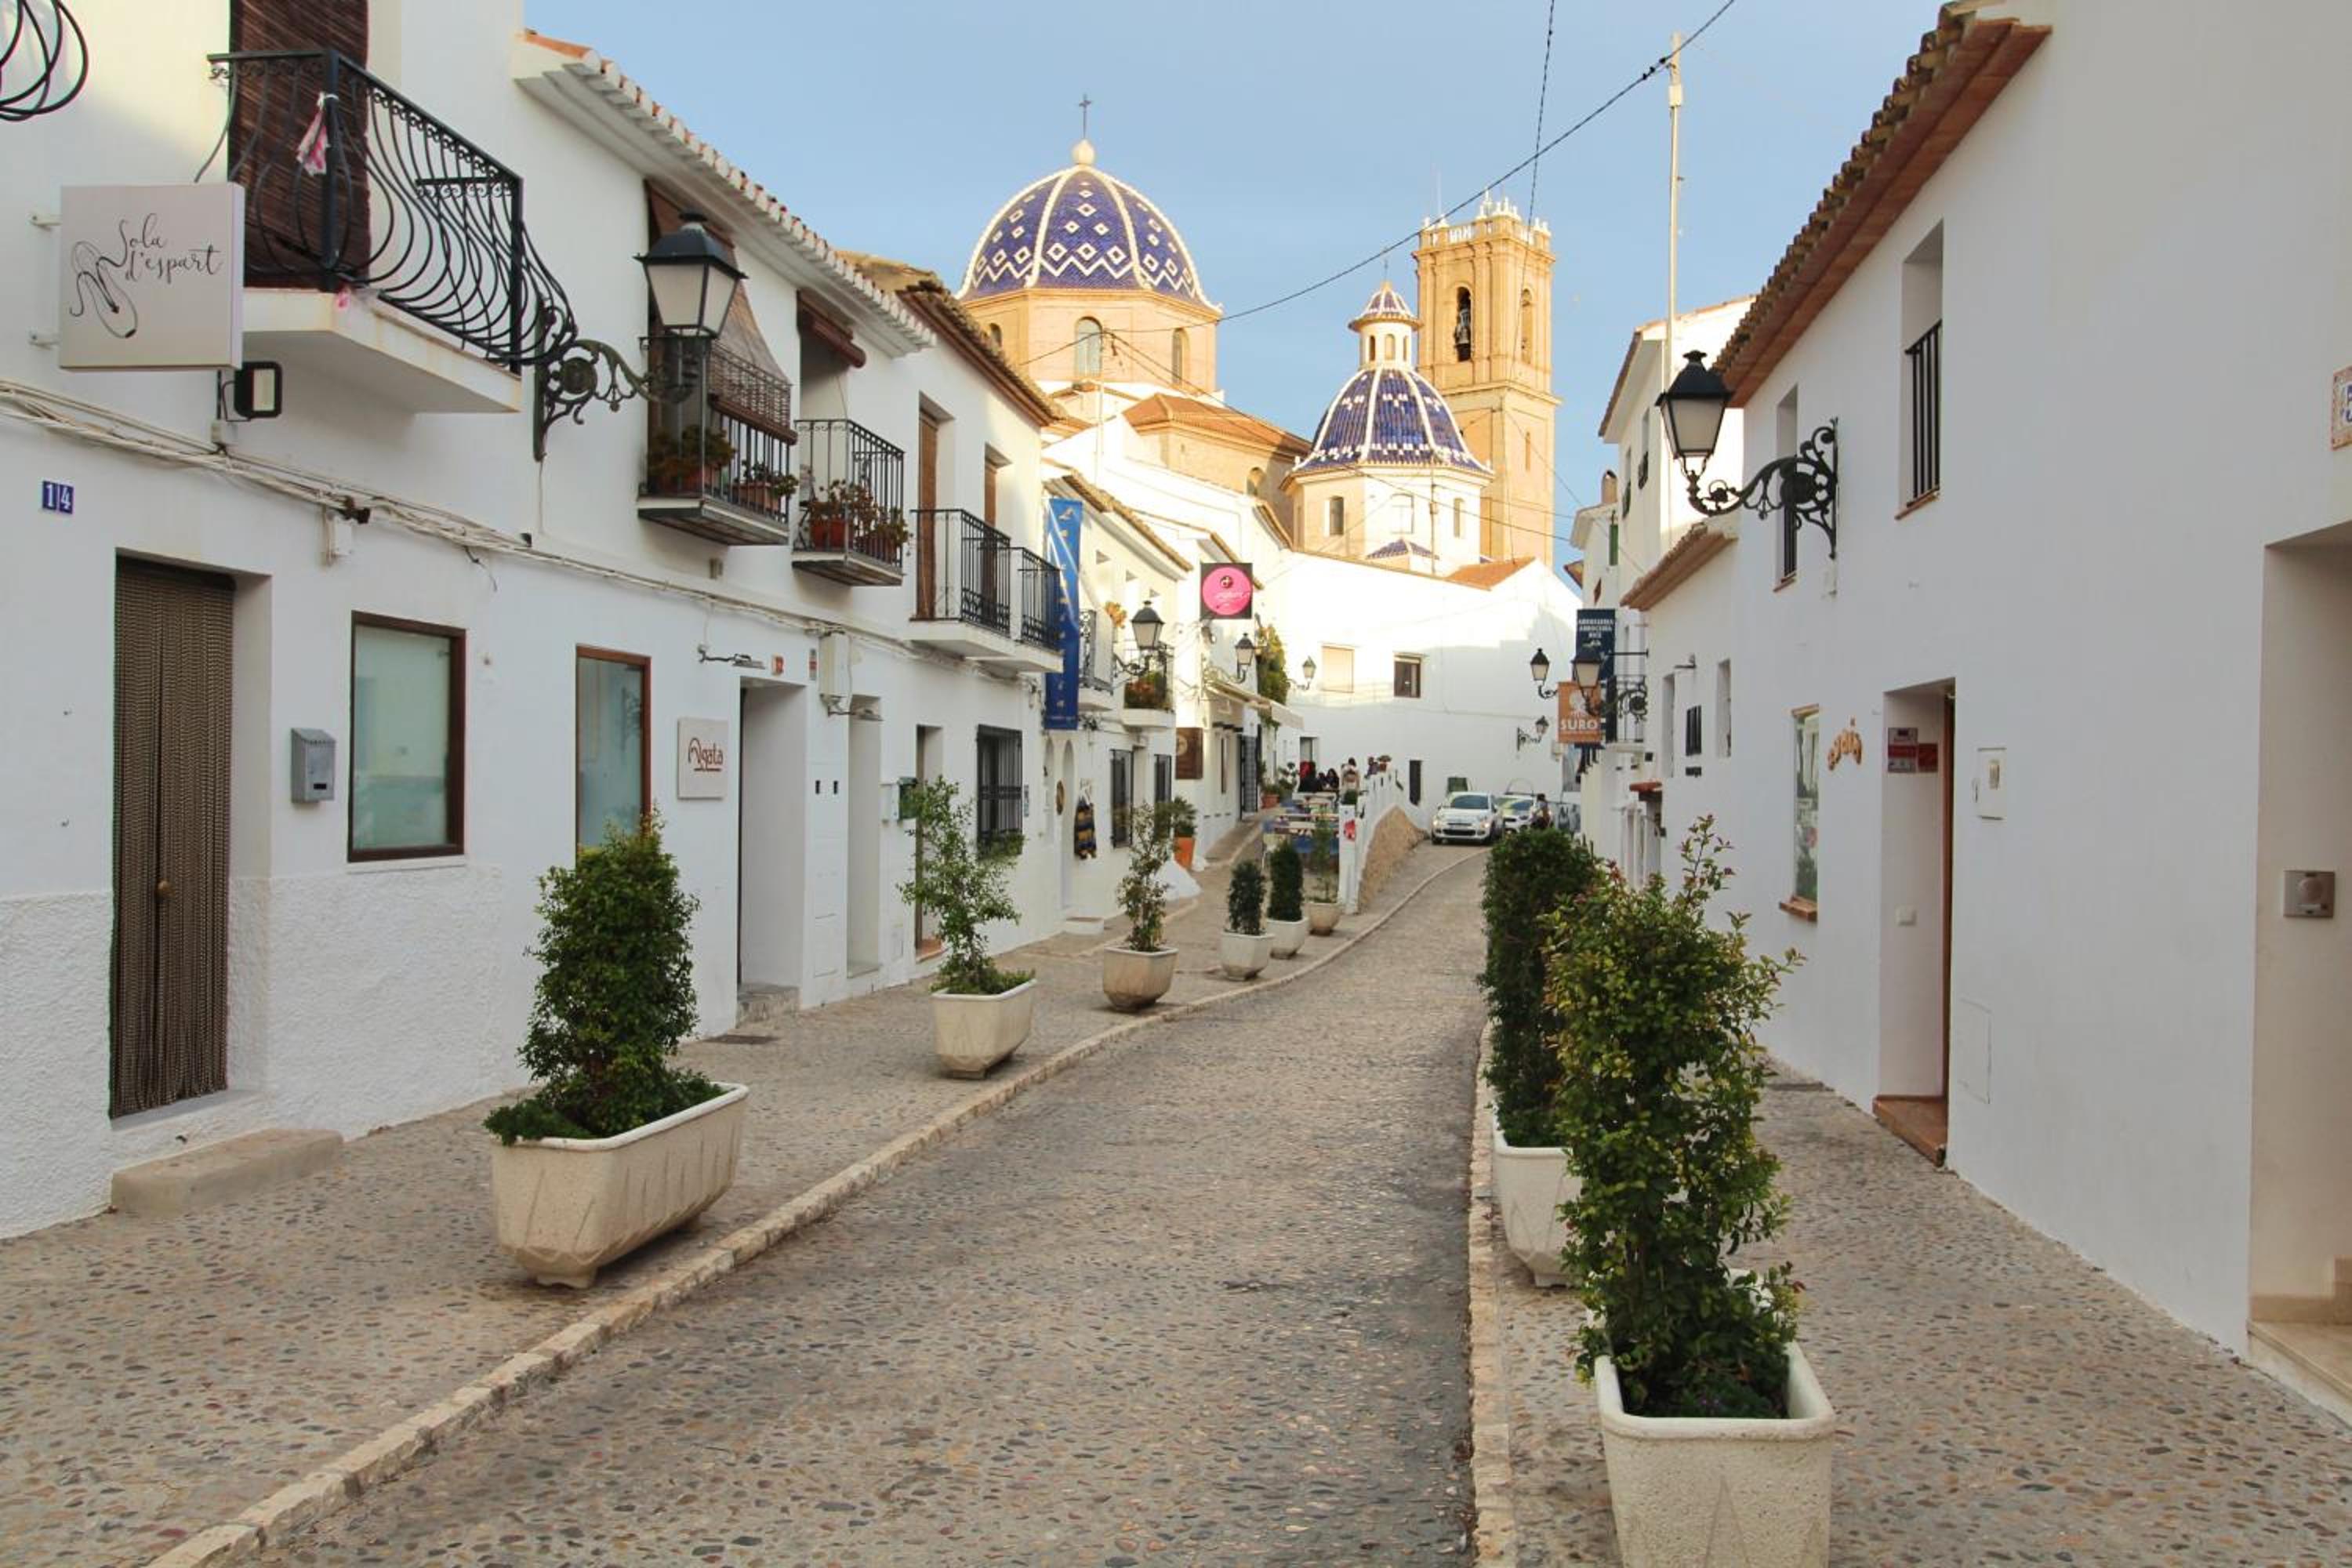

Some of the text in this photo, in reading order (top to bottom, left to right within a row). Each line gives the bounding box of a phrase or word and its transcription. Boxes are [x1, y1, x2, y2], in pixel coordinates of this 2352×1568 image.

[118, 212, 165, 261] Sola
[125, 244, 223, 285] d'espart
[45, 483, 72, 510] 14
[1560, 719, 1598, 730] SURO
